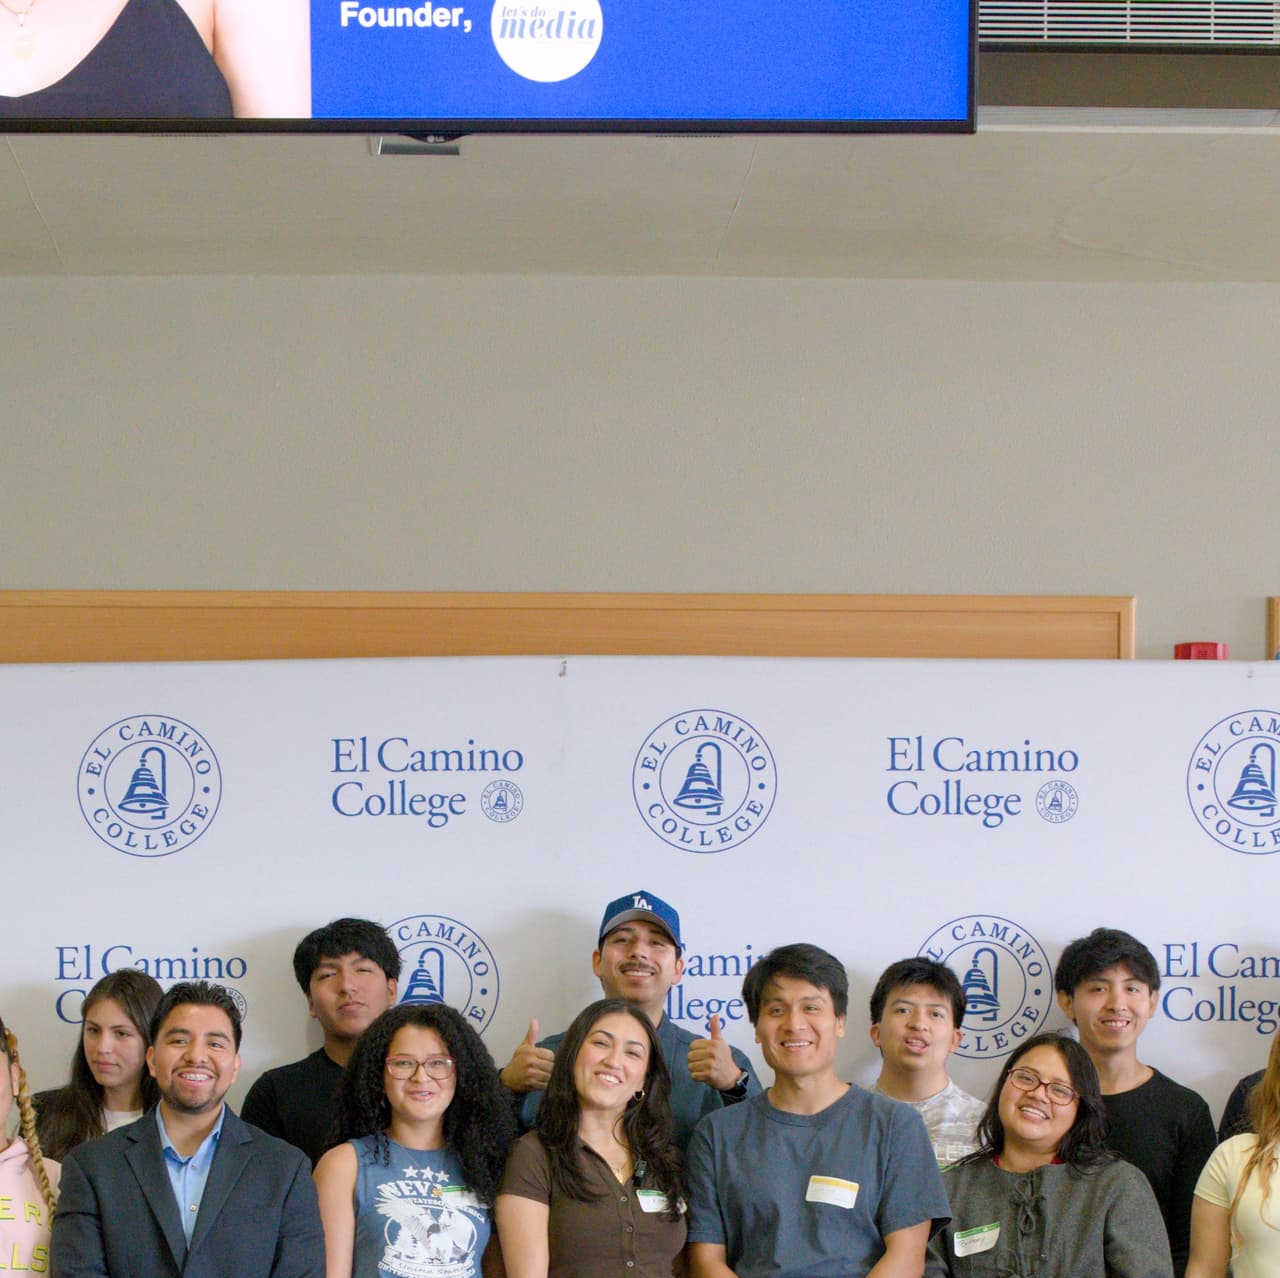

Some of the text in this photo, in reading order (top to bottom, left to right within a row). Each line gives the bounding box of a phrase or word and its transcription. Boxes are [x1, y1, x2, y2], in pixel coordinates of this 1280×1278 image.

[340, 2, 471, 32] Founder,
[499, 11, 596, 39] media
[86, 721, 211, 776] EL CAMINO
[331, 736, 524, 773] El Camino
[641, 716, 766, 772] EL CAMINO
[886, 736, 1080, 773] El Camino
[1196, 743, 1221, 772] EL
[332, 780, 467, 828] College
[493, 782, 520, 798] CAMINO
[887, 779, 1022, 828] College
[94, 804, 208, 850] COLLEGE
[485, 806, 520, 820] COLLEGE
[649, 800, 764, 846] COLLEGE
[632, 895, 652, 911] LA
[55, 944, 93, 980] El
[398, 921, 489, 976] CAMINO
[951, 921, 1043, 977] CAMINO
[1162, 942, 1200, 978] El
[667, 984, 744, 1032] llege
[958, 1005, 1040, 1052] LEGE
